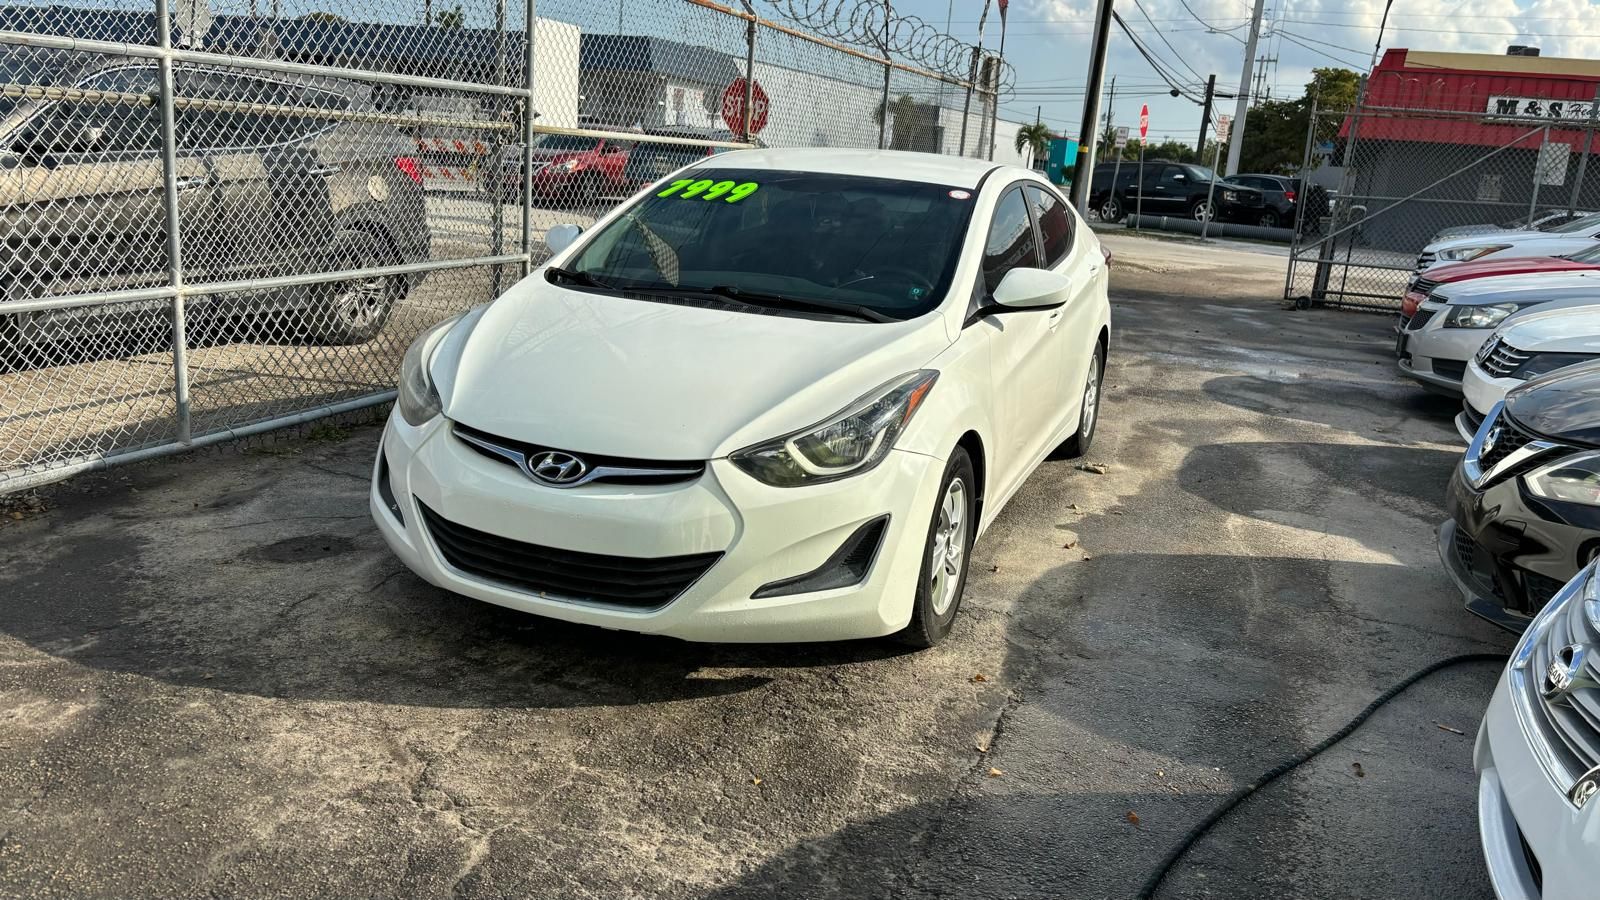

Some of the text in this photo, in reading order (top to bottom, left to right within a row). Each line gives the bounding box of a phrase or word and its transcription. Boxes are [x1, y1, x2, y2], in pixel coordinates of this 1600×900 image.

[725, 95, 765, 121] STP
[1496, 99, 1519, 115] M
[1523, 100, 1542, 117] &
[1547, 101, 1563, 118] S
[657, 179, 759, 204] 7999
